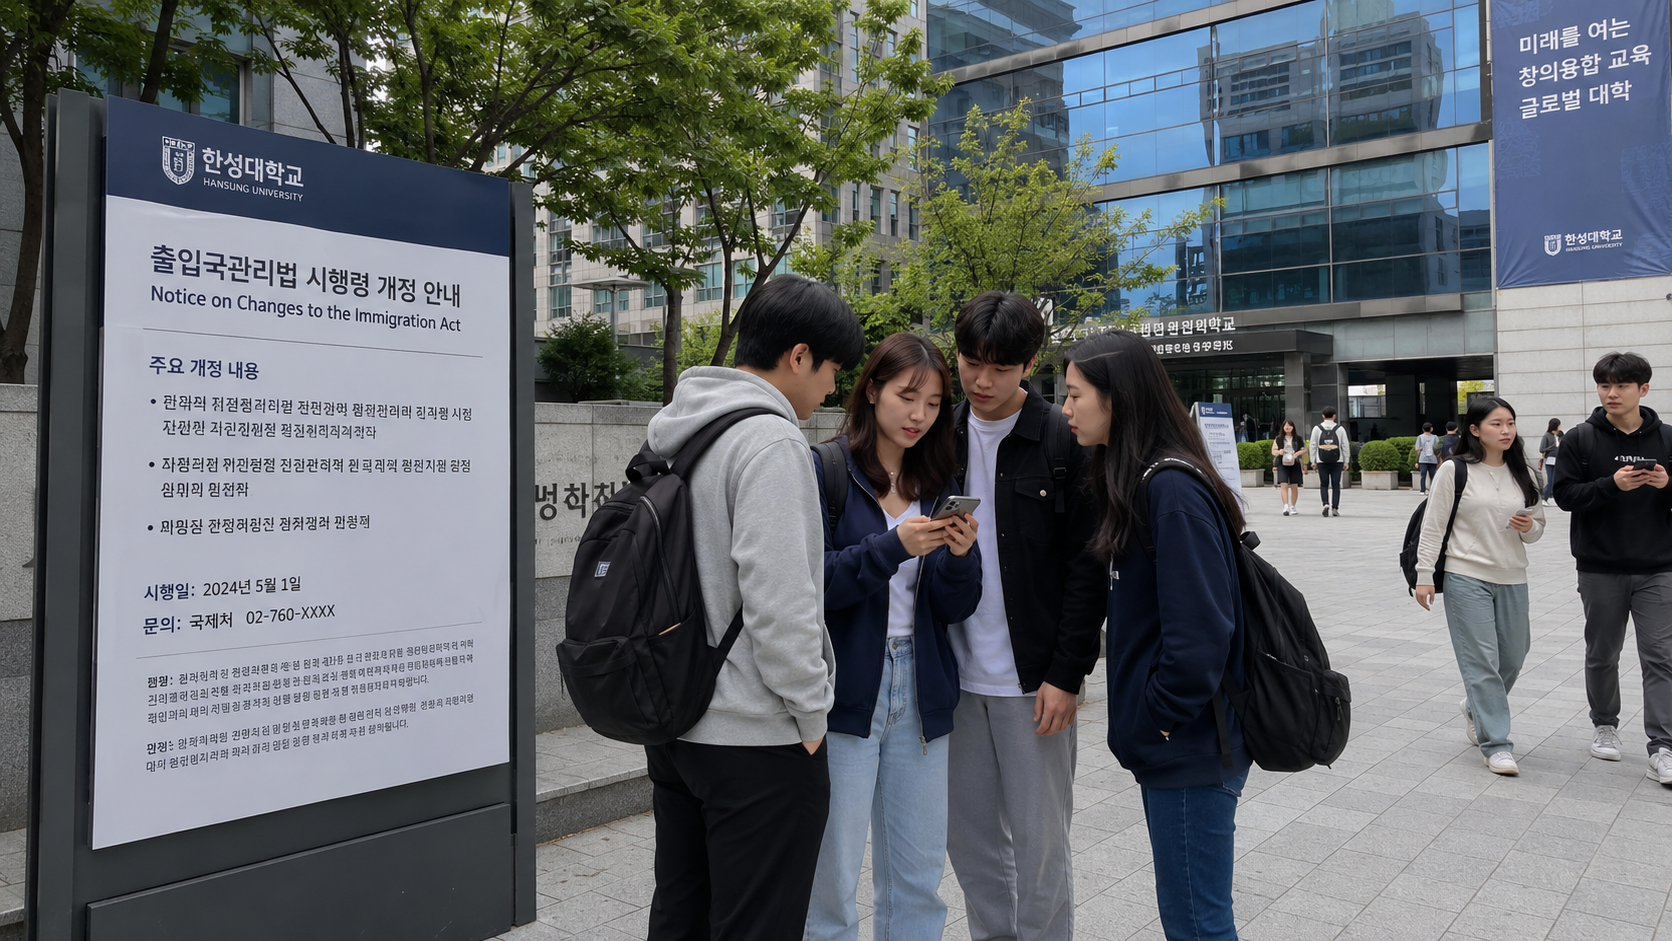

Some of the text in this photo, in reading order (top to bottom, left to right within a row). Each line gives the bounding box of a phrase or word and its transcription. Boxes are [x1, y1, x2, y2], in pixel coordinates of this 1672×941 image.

[1519, 17, 1631, 55] 미래를 여는
[1518, 44, 1652, 88] 창의융합 교육
[1519, 80, 1633, 120] 글로벌 대학
[202, 147, 304, 188] 한성대학교
[203, 177, 304, 202] HANSUNG UNIVERSITY
[1564, 228, 1623, 246] 한성대학교
[150, 244, 460, 309] 출입국관리법 시행령 개정 안내
[151, 286, 461, 332] Notice on Changes to the Immigration Act
[149, 356, 260, 380] 주요 개정 내용
[143, 576, 301, 601] 시행일: 2024년 5월 1일
[143, 604, 336, 635] 문의: 국제처 02-760-XXXX
